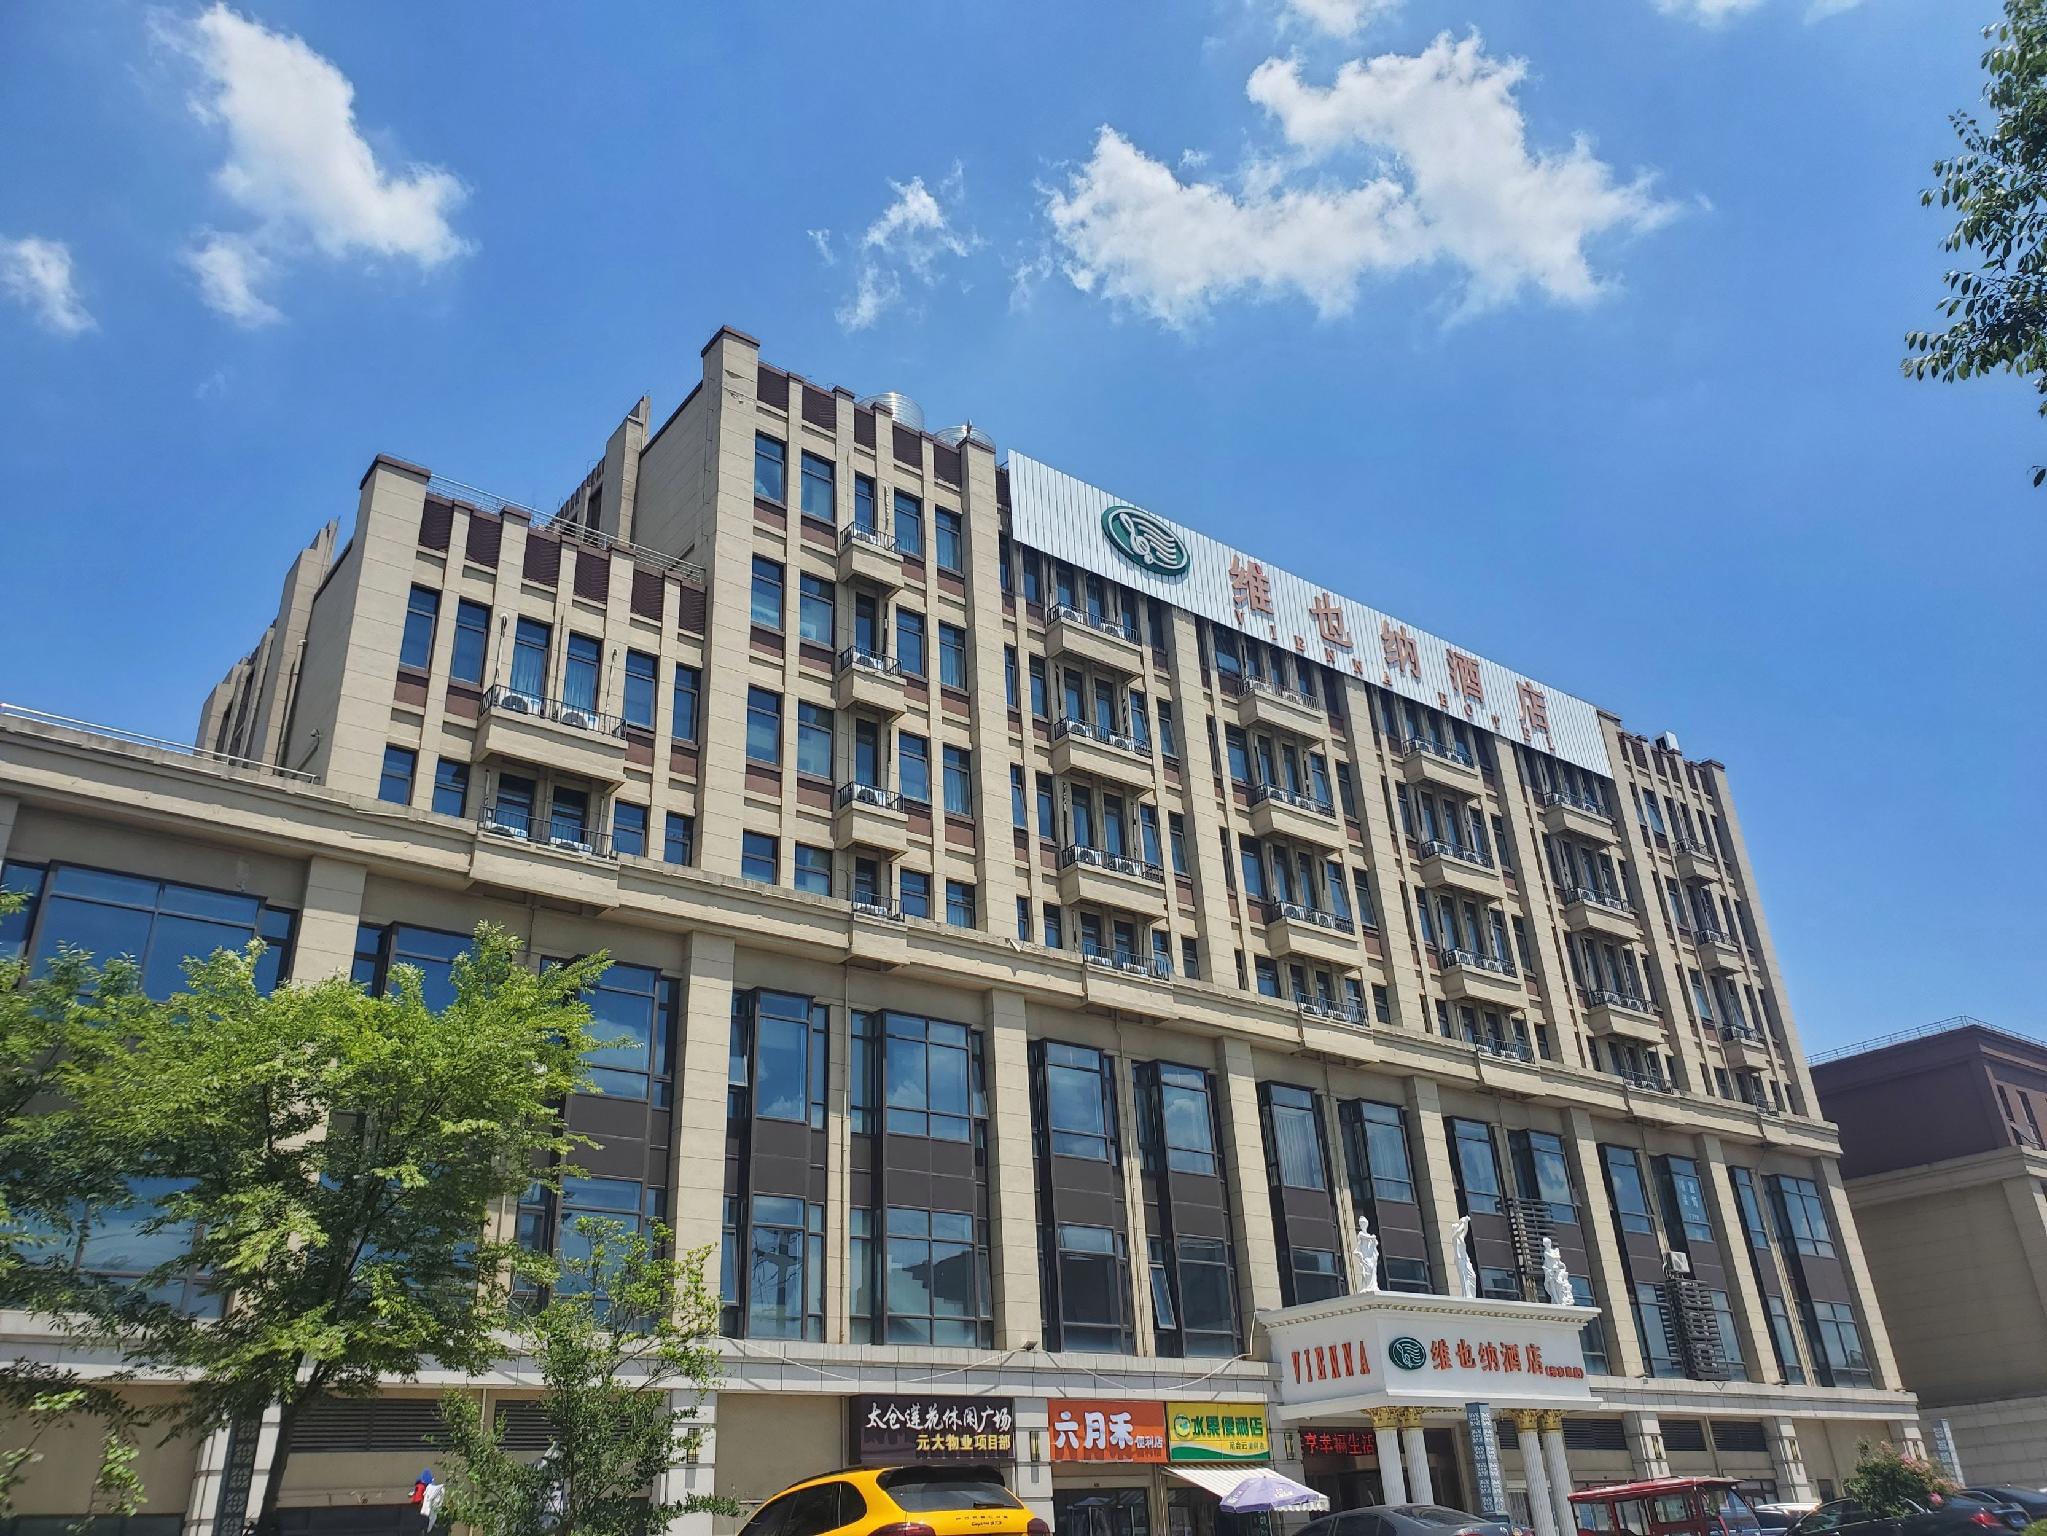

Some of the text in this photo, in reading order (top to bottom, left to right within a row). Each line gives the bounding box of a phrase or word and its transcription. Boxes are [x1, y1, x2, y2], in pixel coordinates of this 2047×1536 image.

[1228, 554, 1549, 731] 维也纳酒店
[1234, 608, 1393, 687] VIENNA
[1291, 1340, 1371, 1385] VIENNA
[1430, 1338, 1543, 1374] 维也纳酒店
[916, 1433, 1011, 1451] 元大物业项目部
[1055, 1411, 1134, 1450] 六月禾
[1135, 1435, 1163, 1449] 便利店
[1191, 1415, 1264, 1436] 水果便利店
